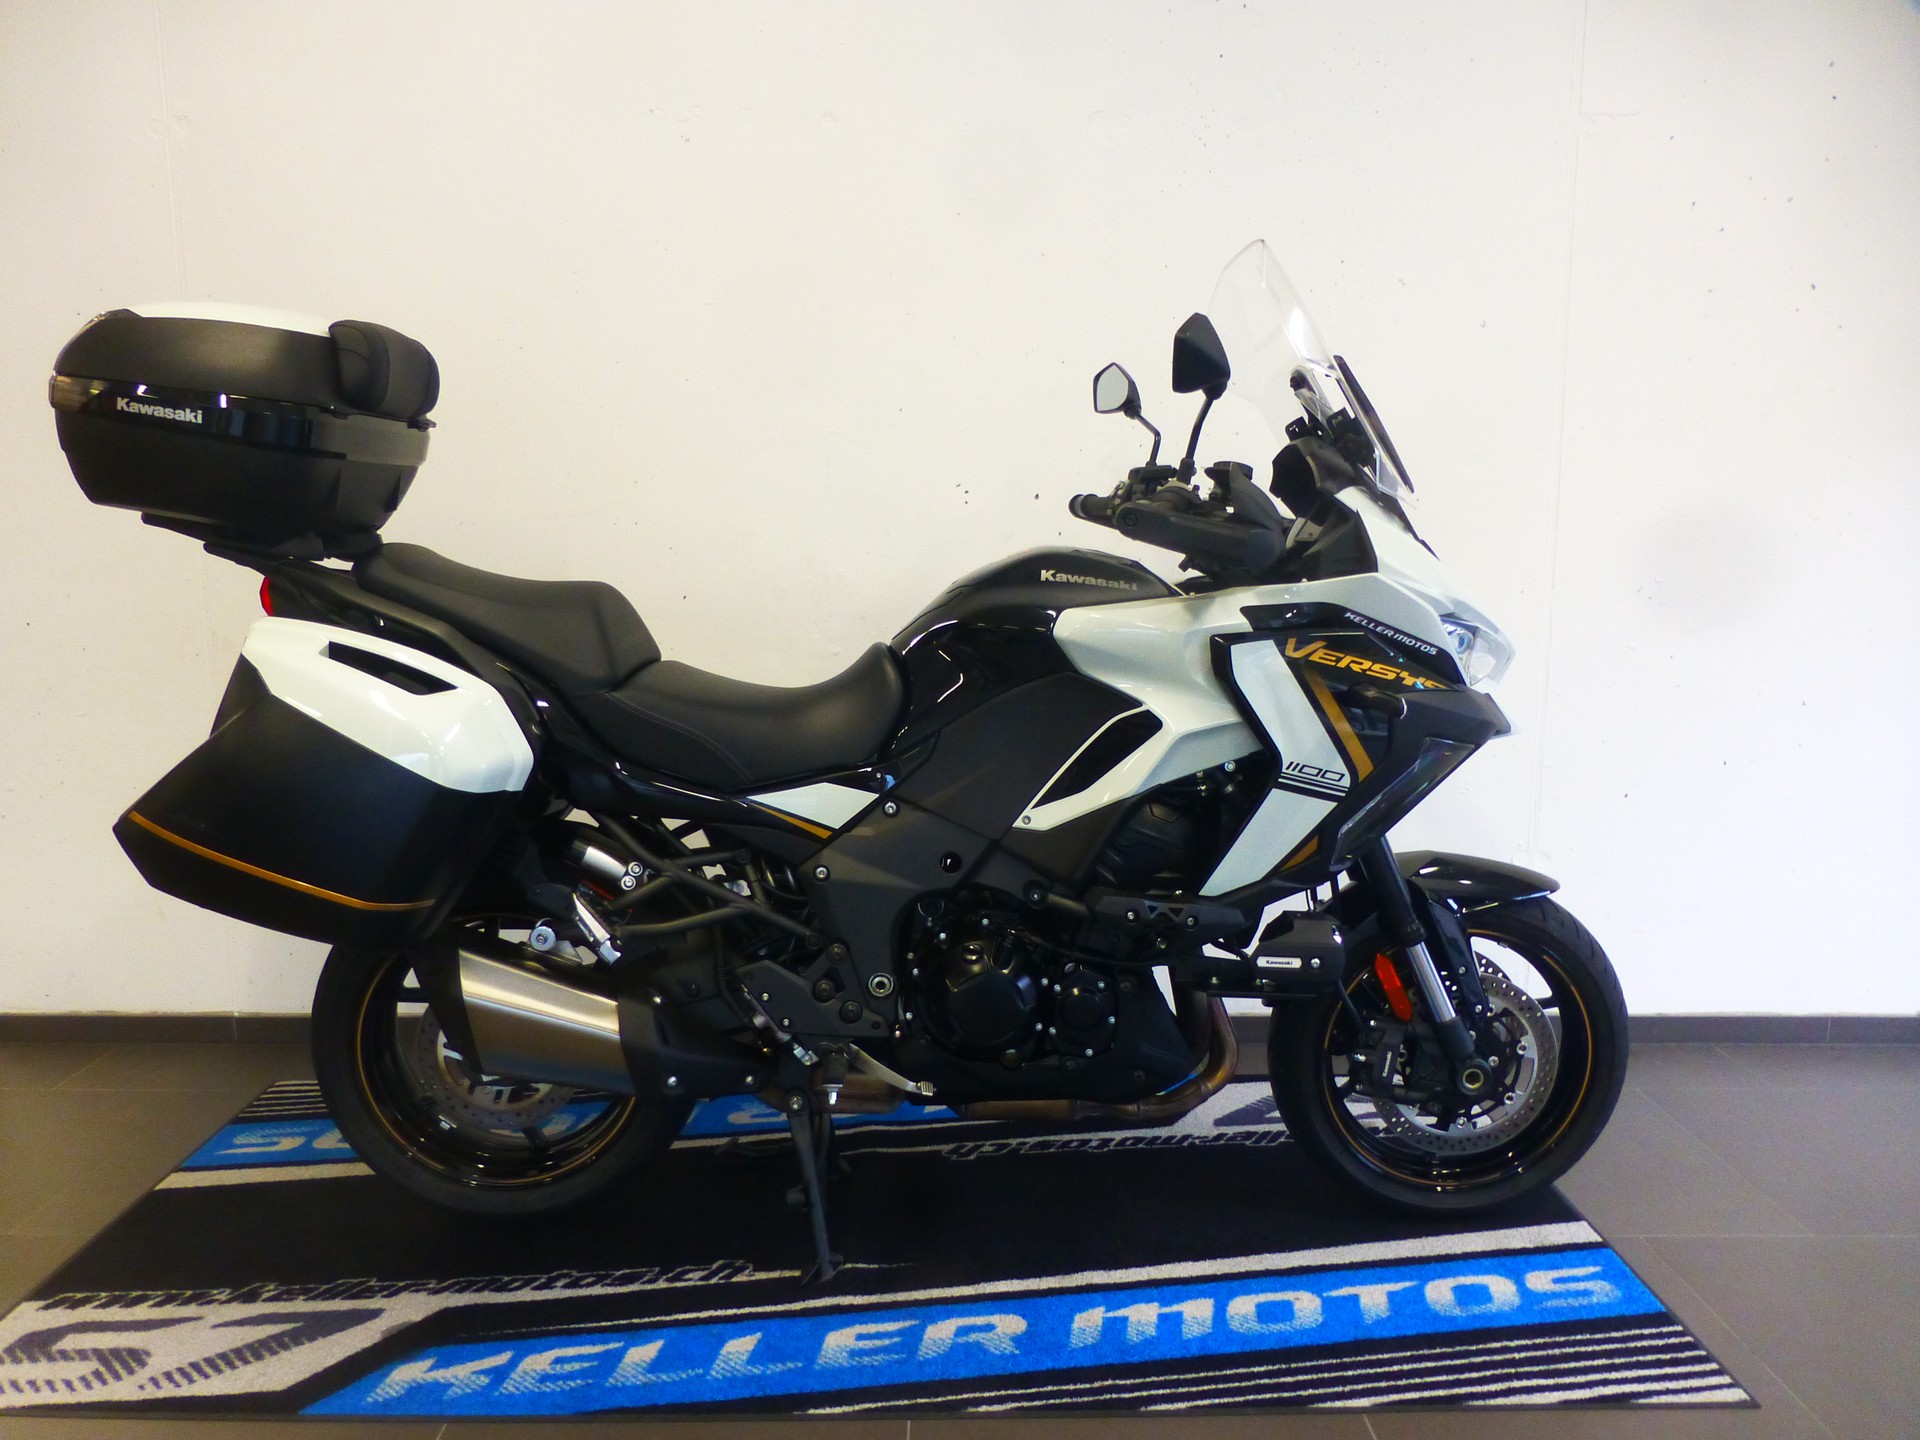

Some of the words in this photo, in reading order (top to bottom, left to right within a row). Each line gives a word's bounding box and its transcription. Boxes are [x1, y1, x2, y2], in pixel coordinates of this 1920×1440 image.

[116, 396, 203, 424] Kawasaki
[1040, 569, 1138, 592] Kawasaki
[1344, 612, 1394, 637] KELLER
[1393, 633, 1439, 655] MOTOS
[1285, 761, 1345, 782] 1100
[361, 1314, 1027, 1403] KELLER
[1069, 1266, 1621, 1350] MOTOS
